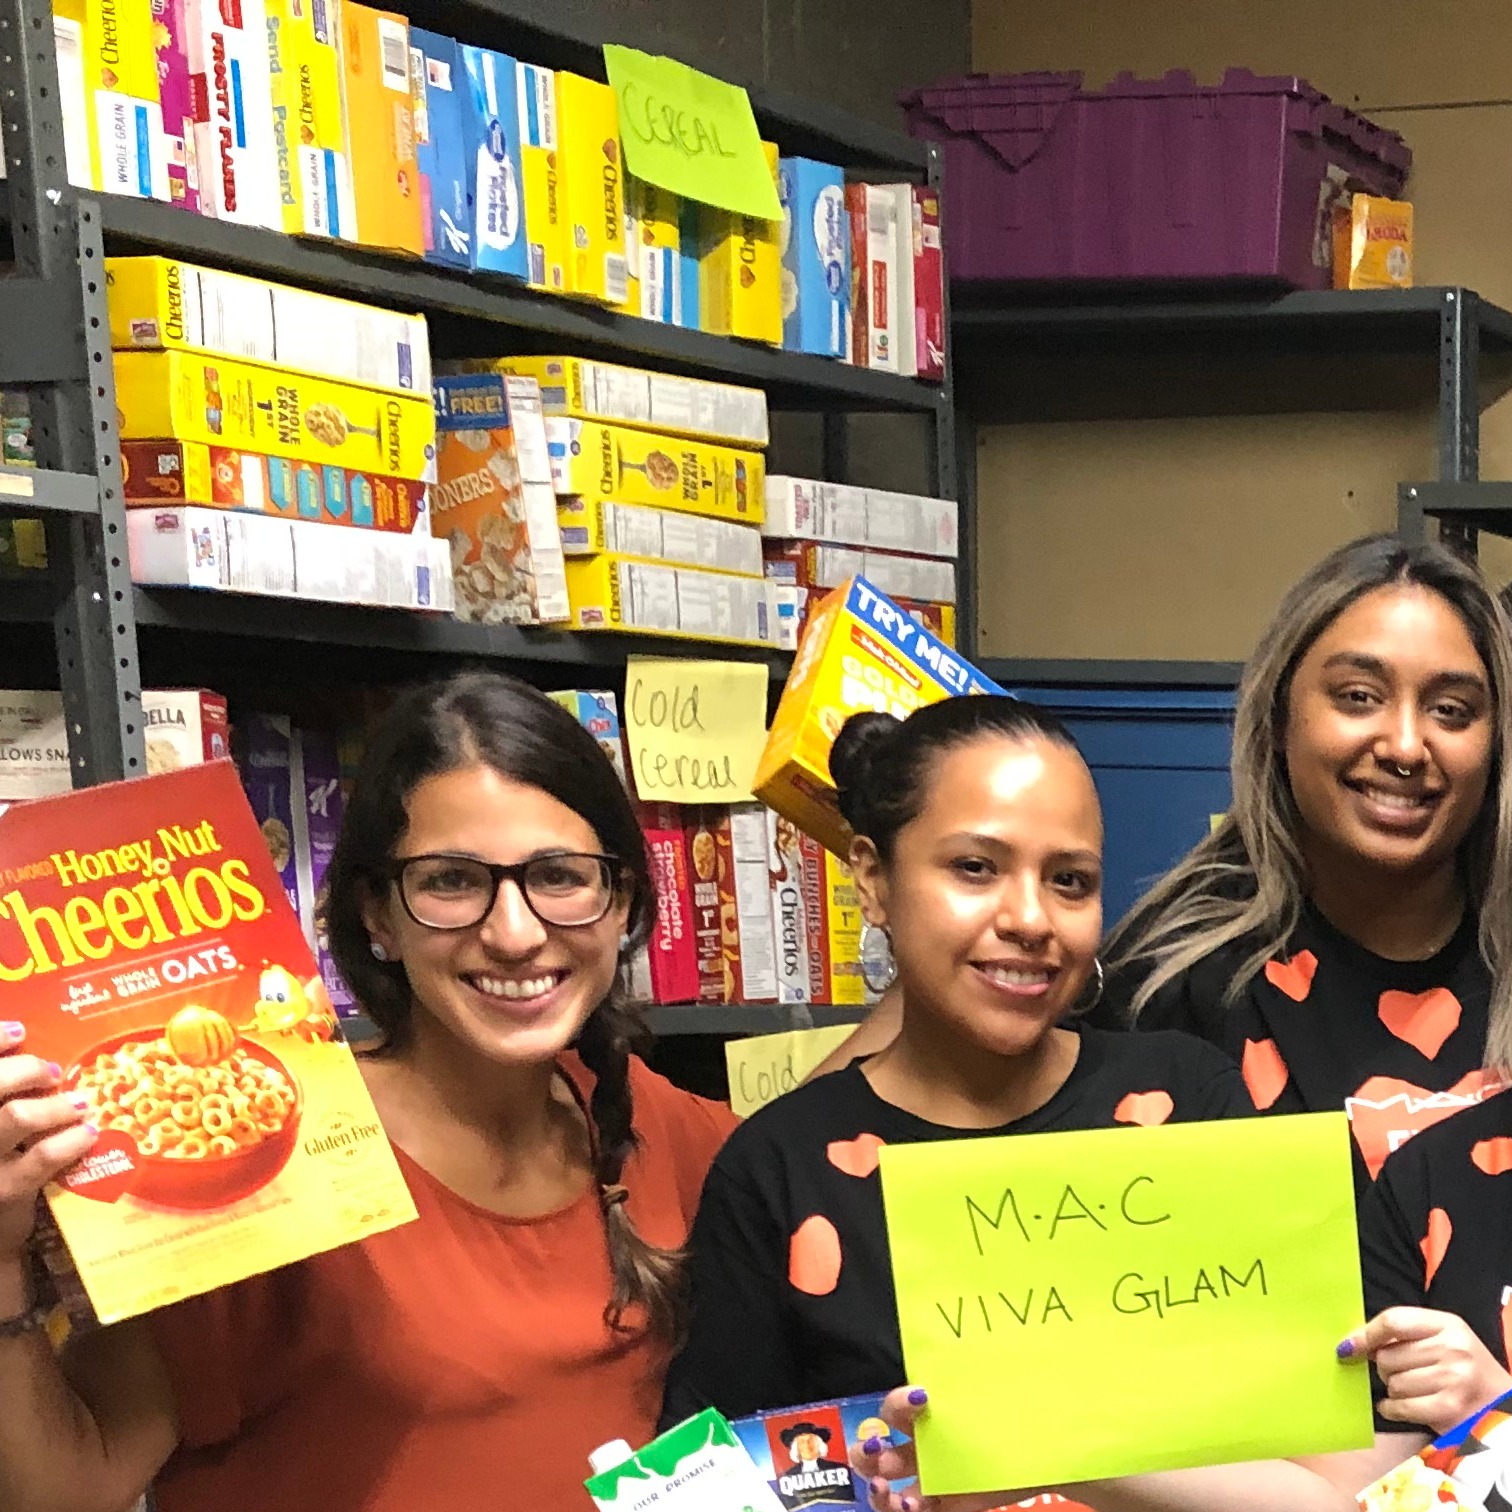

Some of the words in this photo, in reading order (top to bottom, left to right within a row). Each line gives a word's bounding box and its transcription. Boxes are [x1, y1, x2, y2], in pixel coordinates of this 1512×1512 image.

[100, 0, 119, 64] Cheerio
[113, 104, 127, 140] GRAIN
[298, 64, 316, 124] Cheerios
[620, 81, 738, 159] CEREAL
[116, 145, 128, 183] WHOLE
[219, 126, 237, 212] FLAKES
[311, 190, 322, 228] WHOLE
[498, 165, 513, 238] Frosted
[547, 171, 558, 226] Cheerios
[602, 165, 618, 242] Cheerios
[165, 265, 184, 341] Cheerios
[276, 386, 290, 445] GRAIN
[288, 388, 301, 446] WHOLE
[450, 396, 502, 415] FREE!
[386, 401, 402, 471] Cheerios
[600, 429, 612, 495] Cheerios
[609, 561, 621, 623] Cheerios
[857, 582, 915, 643] TRY
[914, 634, 969, 693] ME!
[632, 678, 706, 733] Cold
[0, 749, 42, 761] LOWS
[639, 747, 737, 790] Cereal
[51, 840, 153, 887] Honey
[157, 820, 223, 861] Nut
[651, 842, 673, 951] strawberry
[663, 839, 684, 941] chocolate
[805, 858, 821, 936] BUNCHES
[780, 887, 799, 977] Cheerios
[111, 966, 158, 985] WHOLE
[116, 976, 162, 998] GRAIN
[162, 945, 238, 984] OATS
[809, 951, 824, 996] OATS
[739, 1054, 801, 1104] Cold
[304, 1130, 352, 1157] Gluten
[352, 1122, 381, 1143] Free
[936, 1285, 1074, 1339] VIVA
[1111, 1257, 1268, 1320] GLAM
[665, 1458, 718, 1492] PROMISE
[779, 1467, 852, 1498] QUAKER
